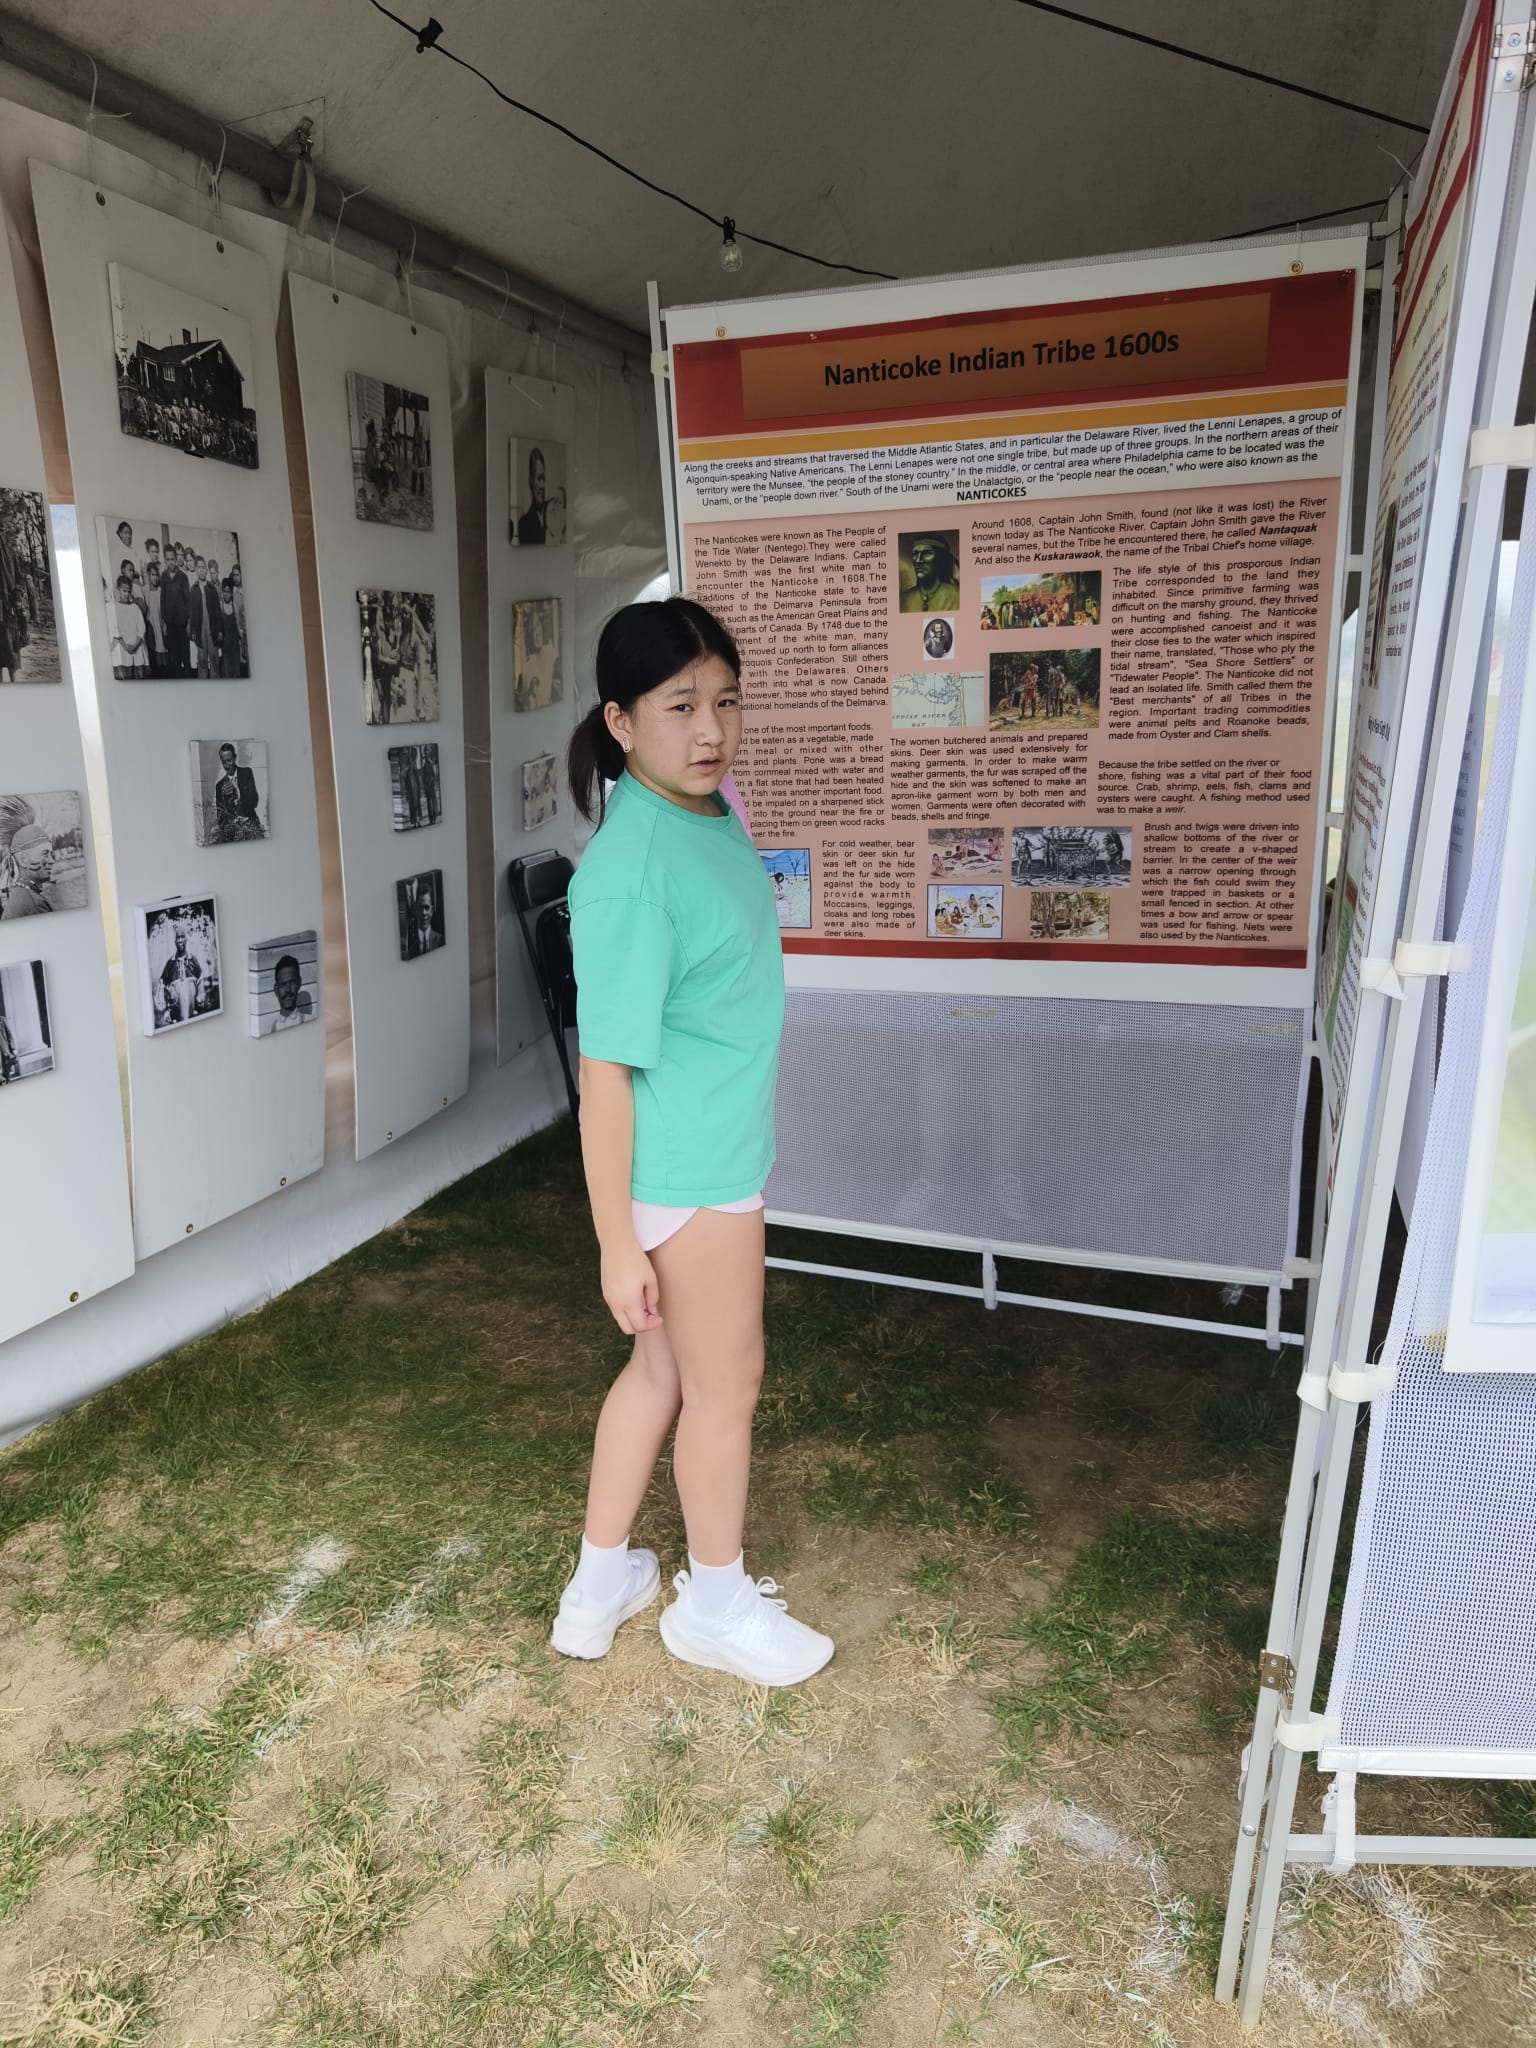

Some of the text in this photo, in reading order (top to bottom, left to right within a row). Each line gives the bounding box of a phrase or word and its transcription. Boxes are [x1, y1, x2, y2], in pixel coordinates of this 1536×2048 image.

[824, 330, 1180, 387] Nanticoke Indian Tribe 1600s
[683, 408, 1343, 474] Along the creeks and streams that traversed the Middle Atlantic States, and in particular the Delaware River, lived the Lenni Lenapes, a group of
[686, 422, 1340, 486] Algonquin-speaking Native Americans. The Lenni Lenapes were not one single tribe, but made up of three groups. In the northern areas of their
[956, 486, 1027, 501] NANTICOKES
[971, 496, 1328, 530] Around 1608, Captain John Smith, found (not like it was lost) the River
[693, 525, 887, 546] The Nanticokes were known as The People of
[974, 536, 1315, 566] And also the Kuskarawaok, the name of the Tribal Chief's home village.
[695, 561, 887, 580] John Smith was the first white man to
[1112, 555, 1321, 577] The life style of this prosporous Indian
[1111, 593, 1319, 613] difficult on the marshy ground, they thrived
[1111, 605, 1319, 625] on hunting and fishing. The Nanticoke
[889, 732, 1089, 747] The women butchered animals and prepared
[1097, 769, 1313, 782] shore, fishing was a vital part of their food
[890, 787, 1087, 802] apron-like garment worn by both men and
[749, 819, 779, 829] placing
[779, 819, 801, 828] them
[813, 819, 838, 829] green
[839, 817, 862, 827] wood
[863, 817, 886, 826] racks
[1144, 821, 1300, 833] Brush and twigs were driven into
[821, 839, 916, 849] For cold weather, bear
